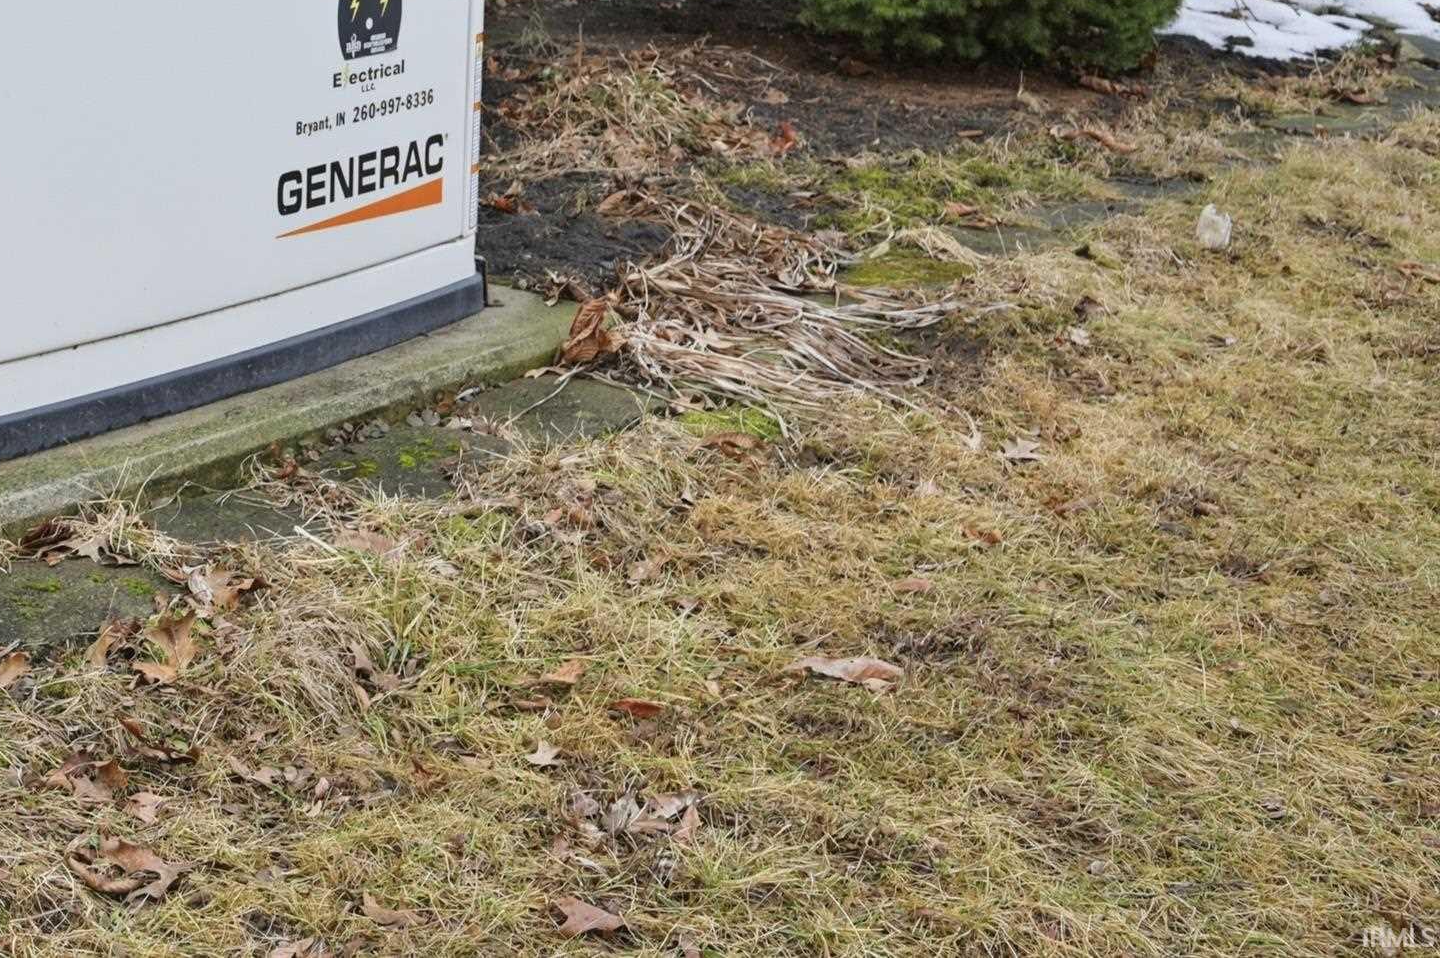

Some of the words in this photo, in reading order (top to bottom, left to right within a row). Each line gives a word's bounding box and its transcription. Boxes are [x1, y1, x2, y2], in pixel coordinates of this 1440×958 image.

[333, 59, 404, 88] Electrical
[296, 116, 332, 136] Bryant,
[336, 112, 345, 126] IN
[353, 89, 433, 123] 260-997-8336
[277, 133, 444, 216] GENERAC
